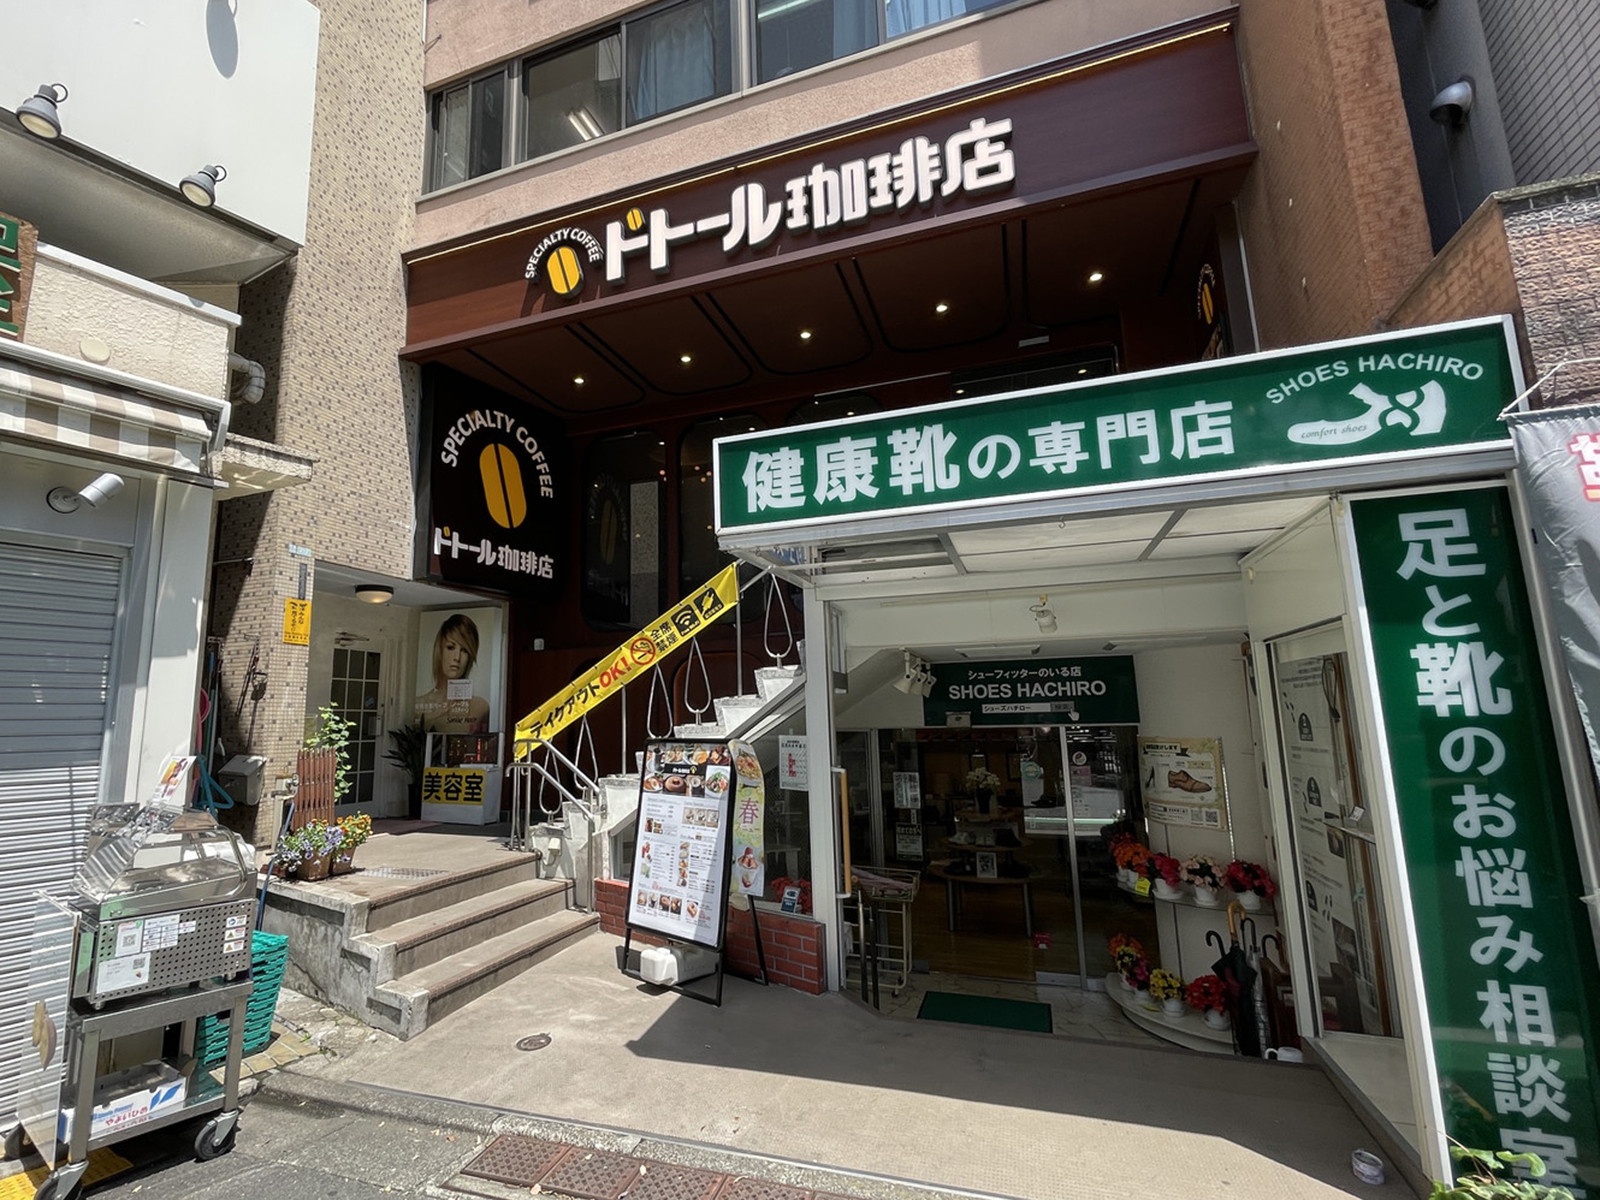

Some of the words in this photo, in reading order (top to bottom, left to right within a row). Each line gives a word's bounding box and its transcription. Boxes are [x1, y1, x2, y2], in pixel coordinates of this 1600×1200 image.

[606, 117, 1014, 282] ドトール珈琲店
[525, 227, 572, 279] SPECIALTY
[570, 228, 600, 263] COFFEE
[1266, 360, 1349, 404] SHOES
[1358, 352, 1484, 381] HACHIRO
[441, 409, 515, 468] SPECIALTY
[516, 426, 554, 499] COFFEE
[742, 399, 1235, 513] 健康靴の専門店
[1301, 426, 1338, 440] comfort
[1341, 422, 1368, 434] shoes
[434, 526, 554, 579] ドトール珈琲店
[949, 683, 1012, 699] SHOES
[1017, 680, 1106, 698] HACHIRO
[968, 666, 1082, 680] シューフィッターのいる店
[984, 704, 1031, 713] シューズハチロー
[423, 772, 484, 802] 美容室
[738, 797, 759, 824] 春
[1396, 508, 1586, 1200] 足と靴のお悩み相談室
